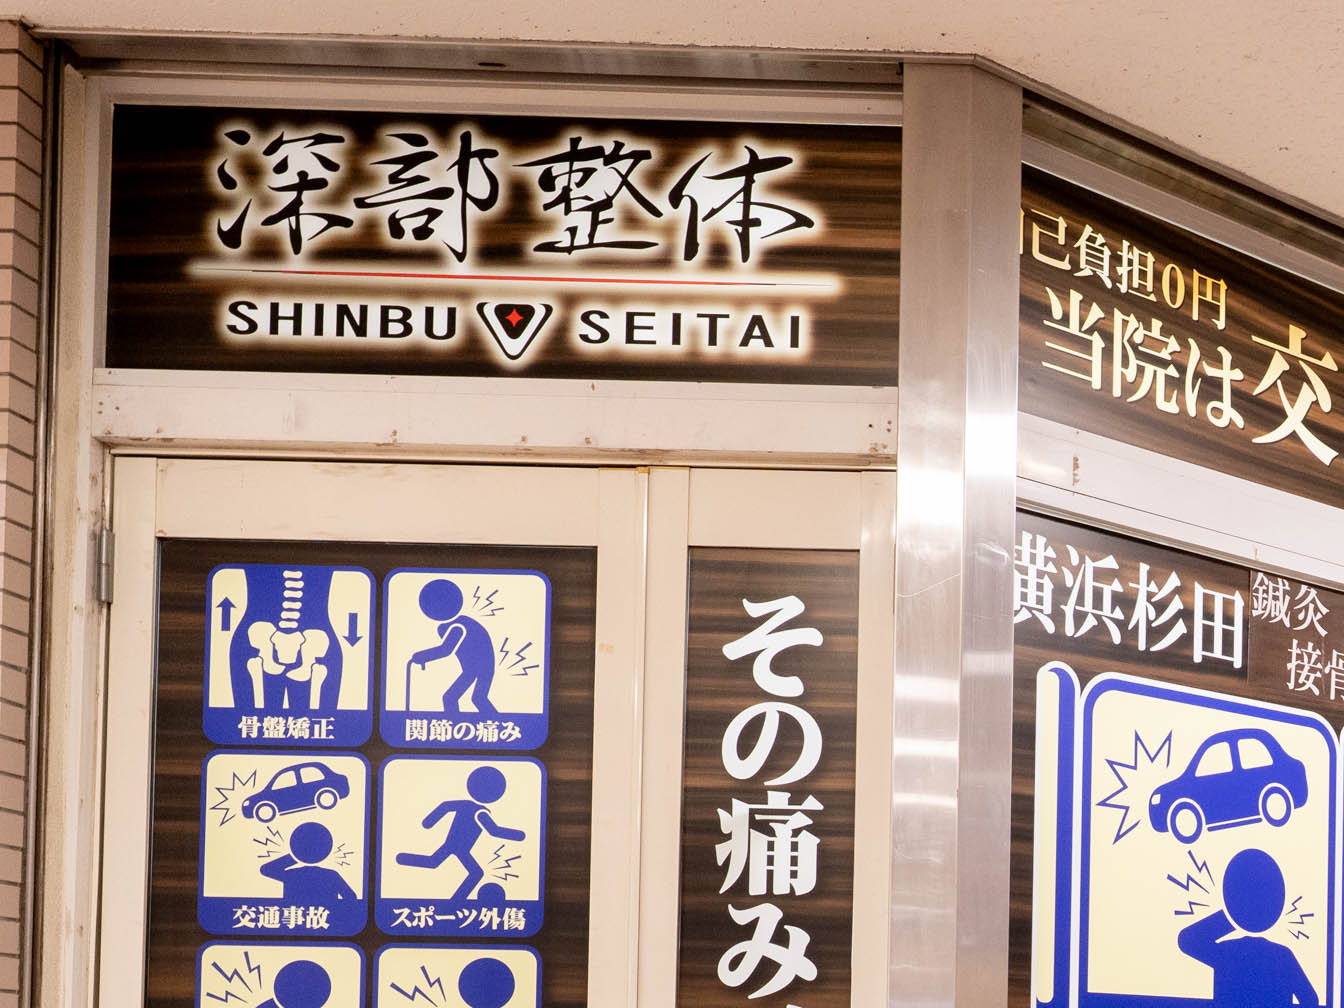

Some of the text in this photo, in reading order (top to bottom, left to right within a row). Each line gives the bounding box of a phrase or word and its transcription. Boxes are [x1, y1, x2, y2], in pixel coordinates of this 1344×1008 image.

[215, 128, 816, 264] 深部整体
[1018, 207, 1228, 330] 己負担0円
[226, 300, 801, 349] SHINBU SEITAI
[1252, 572, 1330, 637] 鍼灸
[237, 715, 336, 740] 骨盤矯正
[404, 718, 522, 743] 関節の痛み
[231, 905, 330, 929] 交通事故
[391, 906, 527, 931] スポーツ外傷
